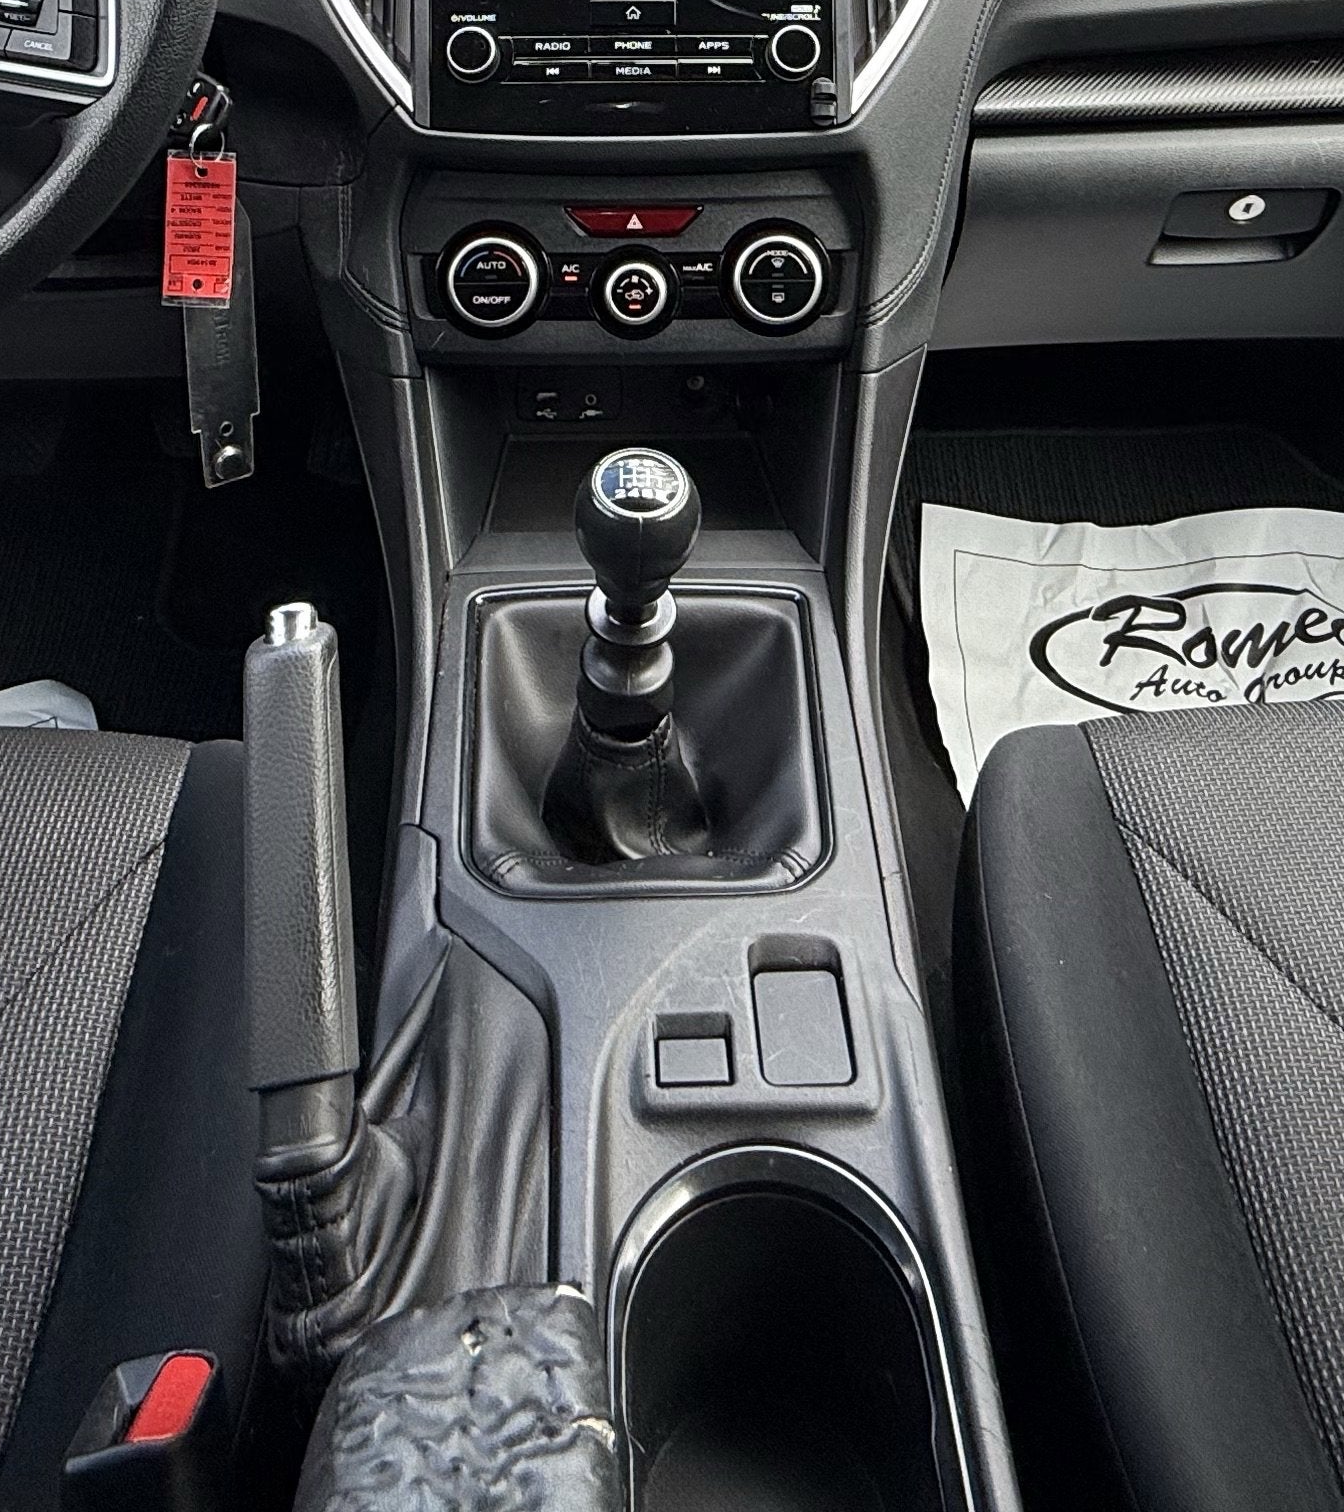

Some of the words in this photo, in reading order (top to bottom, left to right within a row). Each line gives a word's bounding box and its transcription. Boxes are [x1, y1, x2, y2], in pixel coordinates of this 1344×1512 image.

[24, 39, 54, 52] CANCEL
[534, 41, 571, 51] RADIO
[614, 41, 653, 50] PHONE
[698, 41, 730, 50] APPS
[615, 66, 652, 76] MEDIA
[476, 261, 507, 270] AUTO
[561, 264, 580, 273] A/C
[696, 263, 713, 272] A/C
[472, 295, 511, 304] ON/OFF
[1129, 663, 1228, 703] Auto
